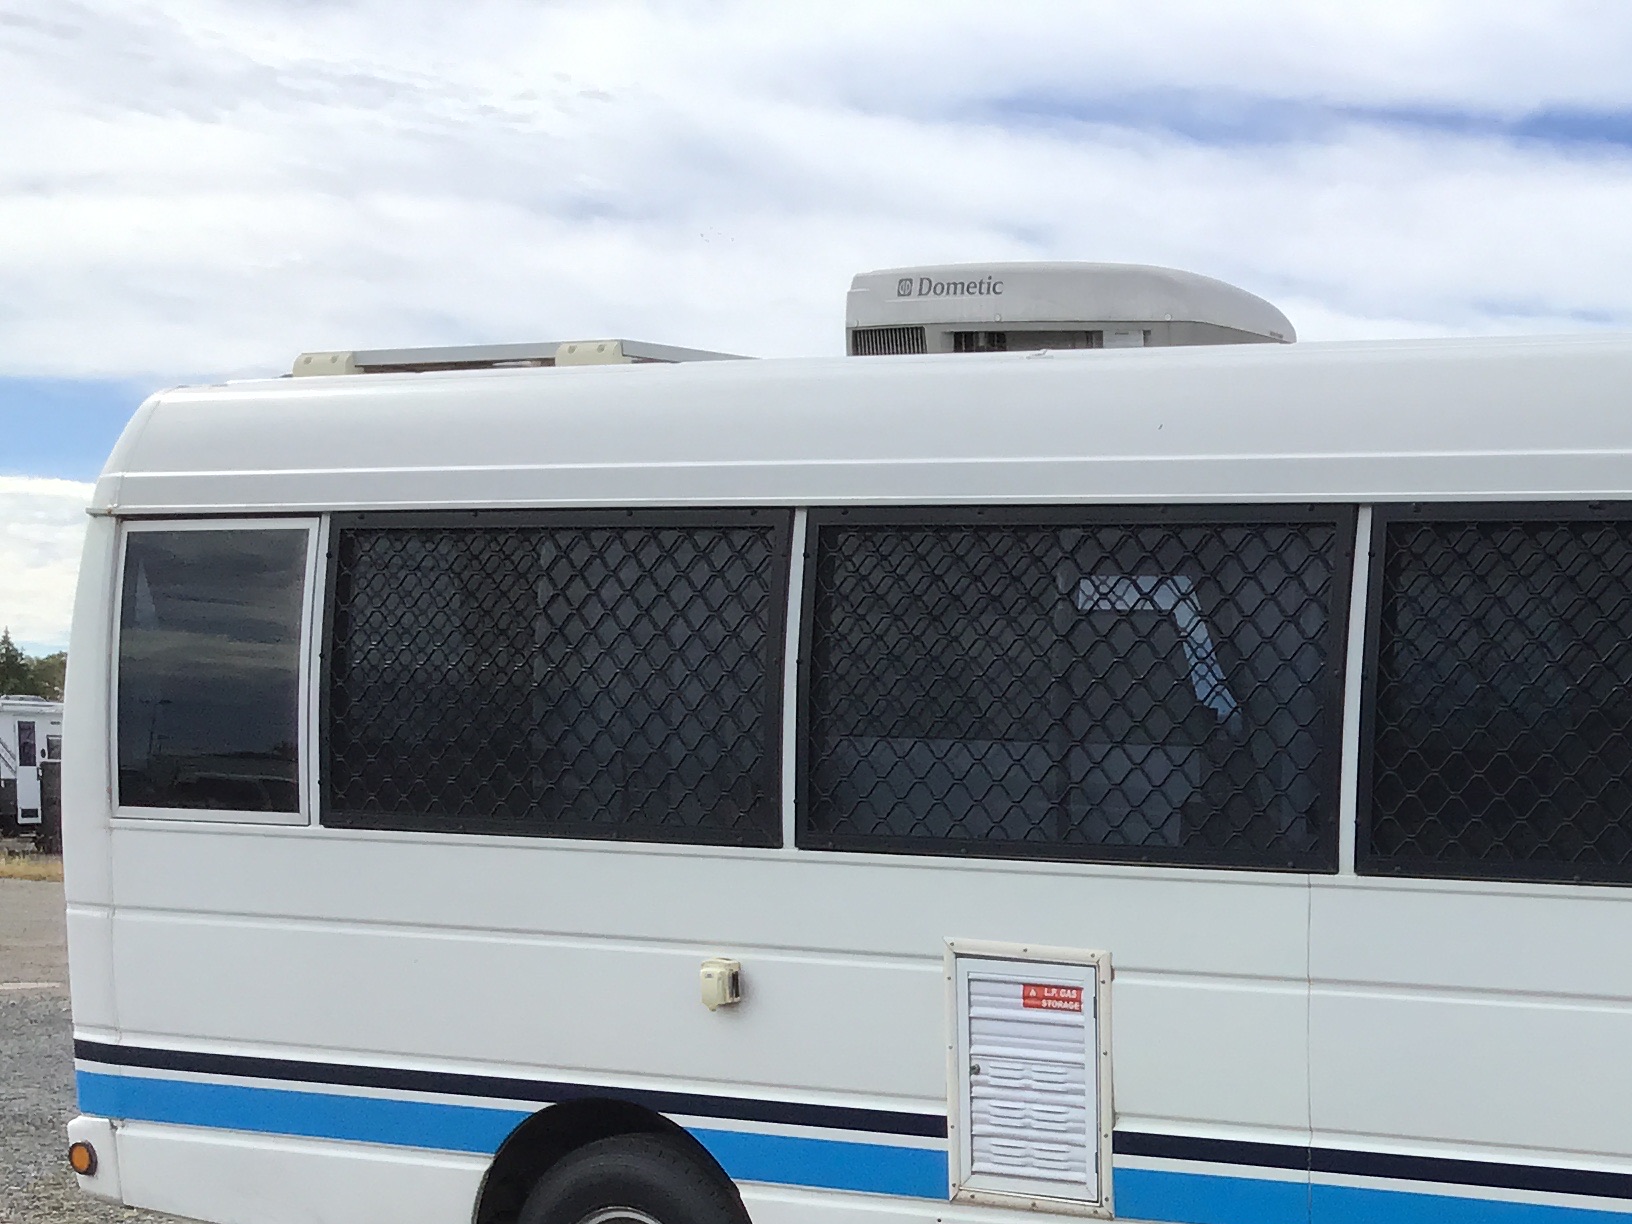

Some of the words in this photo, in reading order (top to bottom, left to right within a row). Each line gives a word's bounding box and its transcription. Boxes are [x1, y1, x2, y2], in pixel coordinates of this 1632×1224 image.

[917, 275, 1004, 297] Dometic
[1060, 989, 1077, 998] GAS
[1041, 999, 1080, 1010] STORAGE
